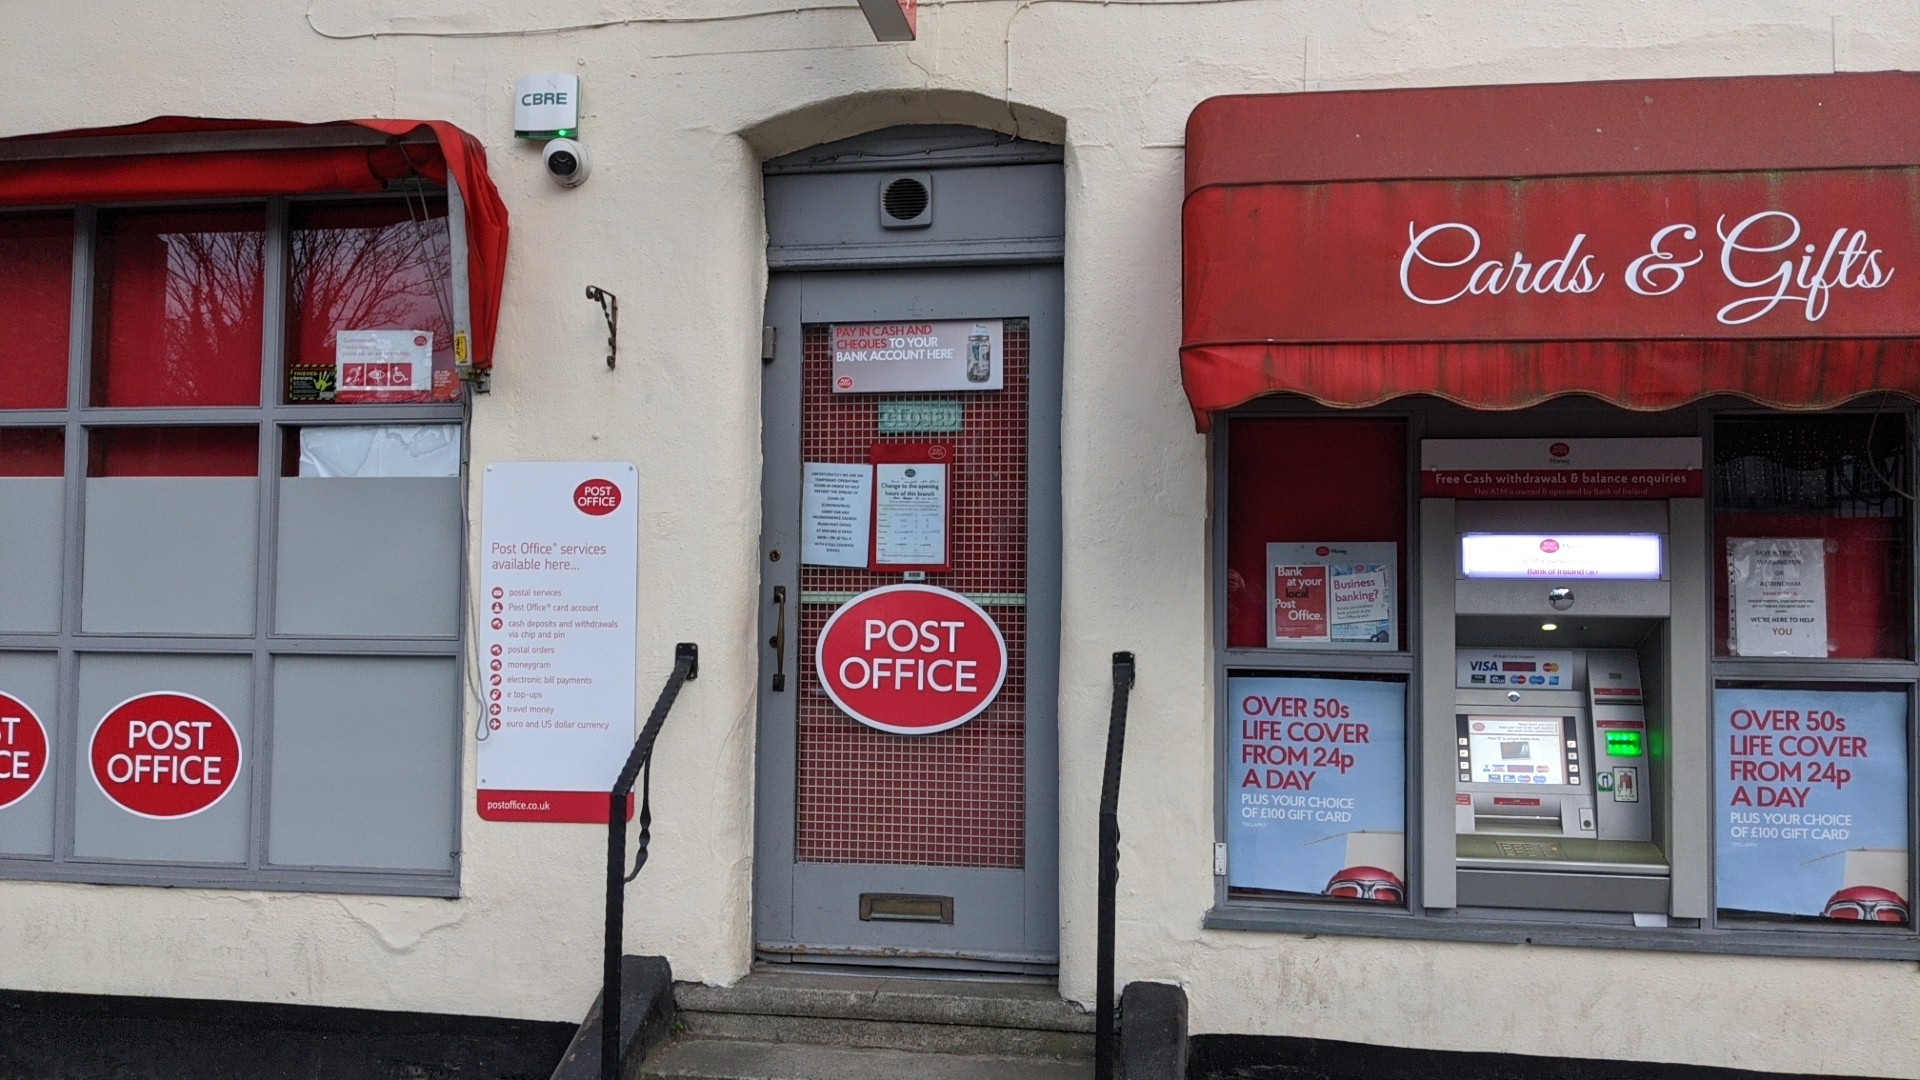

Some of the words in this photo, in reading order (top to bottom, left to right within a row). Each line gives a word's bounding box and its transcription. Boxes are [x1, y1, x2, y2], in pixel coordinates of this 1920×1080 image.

[521, 92, 568, 106] CBRE
[1400, 220, 1605, 304] Cards
[1625, 223, 1703, 295] &
[1716, 210, 1895, 325] Gifts
[836, 327, 857, 337] PAY
[859, 327, 870, 337] IN
[872, 326, 904, 337] CASH
[906, 325, 932, 335] AND
[836, 338, 887, 350] CHEQUES
[889, 337, 905, 348] TO
[906, 336, 938, 348] YOUR
[836, 351, 867, 362] BANK
[869, 349, 925, 361] ACCOUNT
[927, 348, 954, 359] HERE
[1435, 474, 1460, 484] Free
[1464, 473, 1493, 484] Cash
[1496, 473, 1567, 484] withdrawals
[1570, 473, 1579, 484] &
[1582, 473, 1628, 484] balance
[1631, 473, 1687, 486] enquiries
[584, 486, 612, 496] POST
[881, 482, 901, 490] Change
[1474, 488, 1489, 496] This
[1490, 488, 1507, 496] ATM
[1515, 488, 1542, 496] owned
[1549, 488, 1582, 497] operated
[1583, 488, 1593, 497] by
[577, 496, 616, 507] OFFICE
[491, 542, 516, 555] Post
[560, 542, 607, 555] services
[491, 558, 541, 570] available
[544, 559, 580, 570] here...
[1278, 566, 1303, 577] Bank
[1557, 568, 1585, 576] Ireland
[1287, 577, 1297, 586] at
[1298, 578, 1322, 589] your
[1333, 578, 1376, 590] Business
[509, 589, 531, 597] postal
[532, 589, 562, 597] services
[1286, 588, 1309, 598] local
[1335, 589, 1379, 603] banking?
[508, 603, 524, 611] Post
[552, 604, 569, 612] card
[1274, 598, 1296, 609] Post
[1288, 610, 1323, 621] Office.
[527, 620, 557, 629] deposits
[558, 620, 573, 628] and
[520, 631, 536, 639] chip
[538, 631, 552, 639] and
[553, 632, 565, 640] pin
[865, 619, 965, 653] POST
[1772, 628, 1793, 636] YOU
[507, 646, 530, 655] postal
[531, 646, 555, 654] orders
[507, 662, 552, 670] moneygram
[1470, 661, 1498, 671] VISA
[839, 656, 977, 692] OFFICE
[507, 675, 542, 684] electronic
[544, 676, 555, 684] bill
[556, 676, 593, 686] payments
[513, 691, 543, 699] top-ups
[507, 705, 528, 713] travel
[529, 706, 555, 715] money
[1243, 695, 1308, 718] OVER
[1313, 698, 1350, 719] 50s
[525, 720, 539, 728] and
[541, 720, 553, 728] US
[554, 720, 575, 729] dollar
[577, 722, 610, 731] currency
[1730, 709, 1800, 731] OVER
[1806, 710, 1846, 732] 50s
[0, 717, 21, 745] T
[128, 720, 212, 750] POST
[1243, 720, 1282, 741] LIFE
[1287, 722, 1370, 744] COVER
[1730, 735, 1773, 756] LIFE
[1778, 735, 1868, 758] COVER
[1242, 744, 1308, 767] FROM
[1313, 747, 1355, 774] 24p
[107, 753, 222, 785] OFFICE
[1730, 760, 1802, 782] FROM
[1807, 761, 1851, 789] 24p
[1242, 768, 1262, 789] A
[1266, 769, 1316, 791] DAY
[1242, 793, 1269, 805] PLUS
[1272, 795, 1306, 807] YOUR
[1308, 796, 1355, 810] CHOICE
[1730, 785, 1753, 807] A
[1757, 786, 1811, 808] DAY
[487, 800, 551, 811] postoffice.co.uk
[1242, 807, 1258, 818] OF
[1260, 808, 1285, 820] £100
[1287, 810, 1313, 821] GIFT
[1730, 812, 1760, 825] PLUS
[1763, 813, 1801, 826] YOUR
[1802, 814, 1853, 827] CHOICE
[1730, 826, 1749, 838] OF
[1750, 827, 1778, 839] £100
[1781, 828, 1809, 840] GIFT
